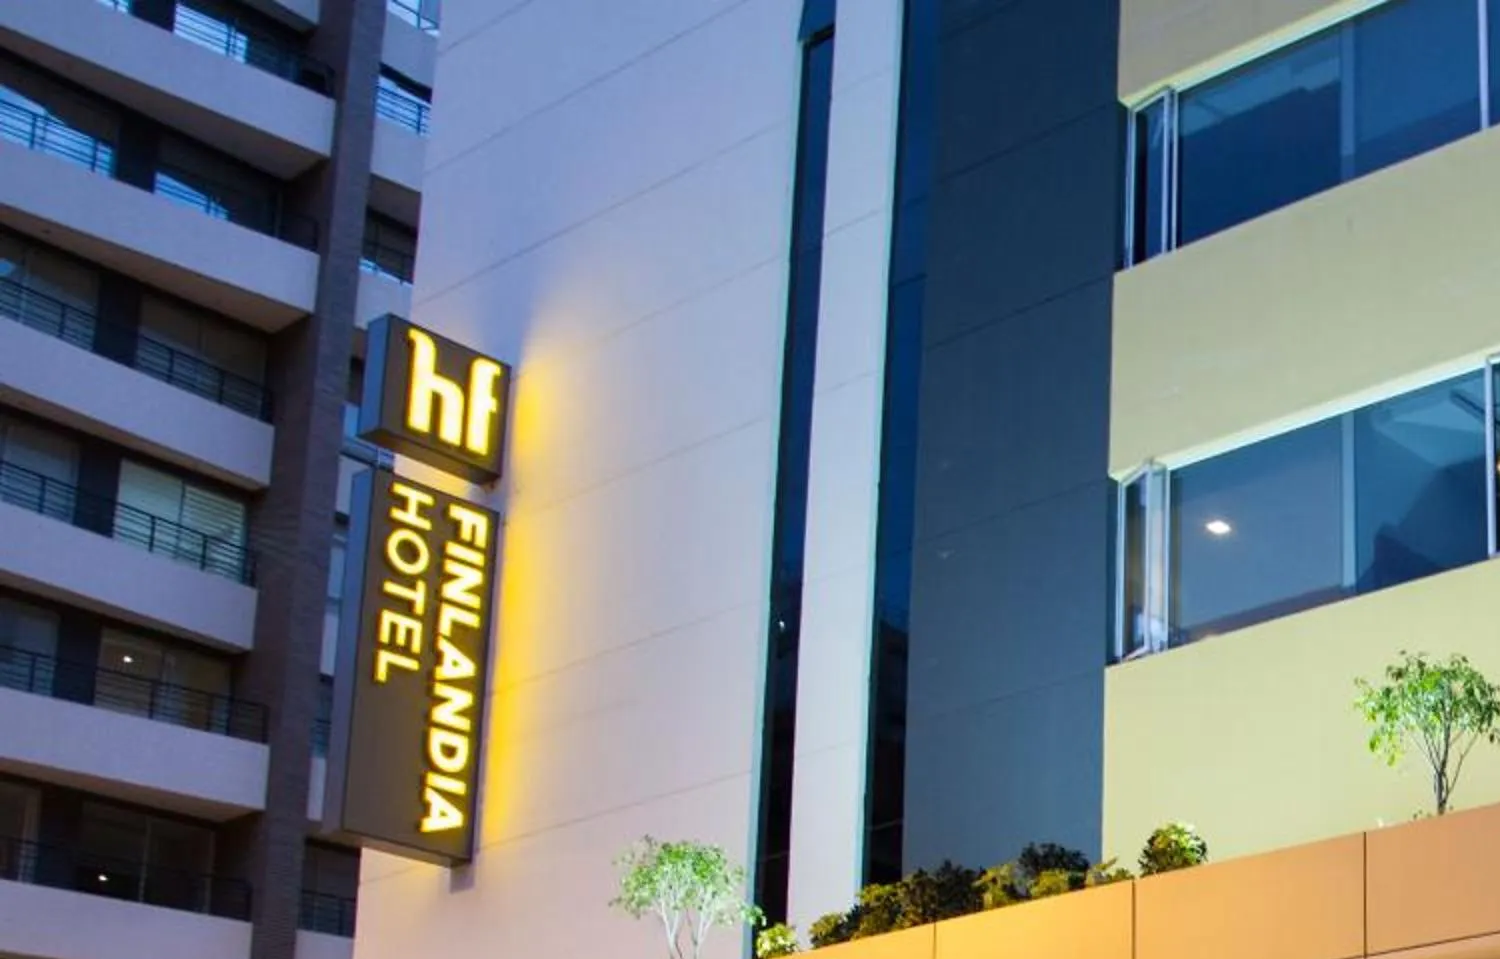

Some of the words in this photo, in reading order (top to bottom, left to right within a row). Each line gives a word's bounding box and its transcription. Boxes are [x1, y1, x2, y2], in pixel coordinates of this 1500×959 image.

[408, 327, 502, 456] hf
[374, 482, 434, 684] HOTEL
[420, 503, 489, 834] FINLANDIA
